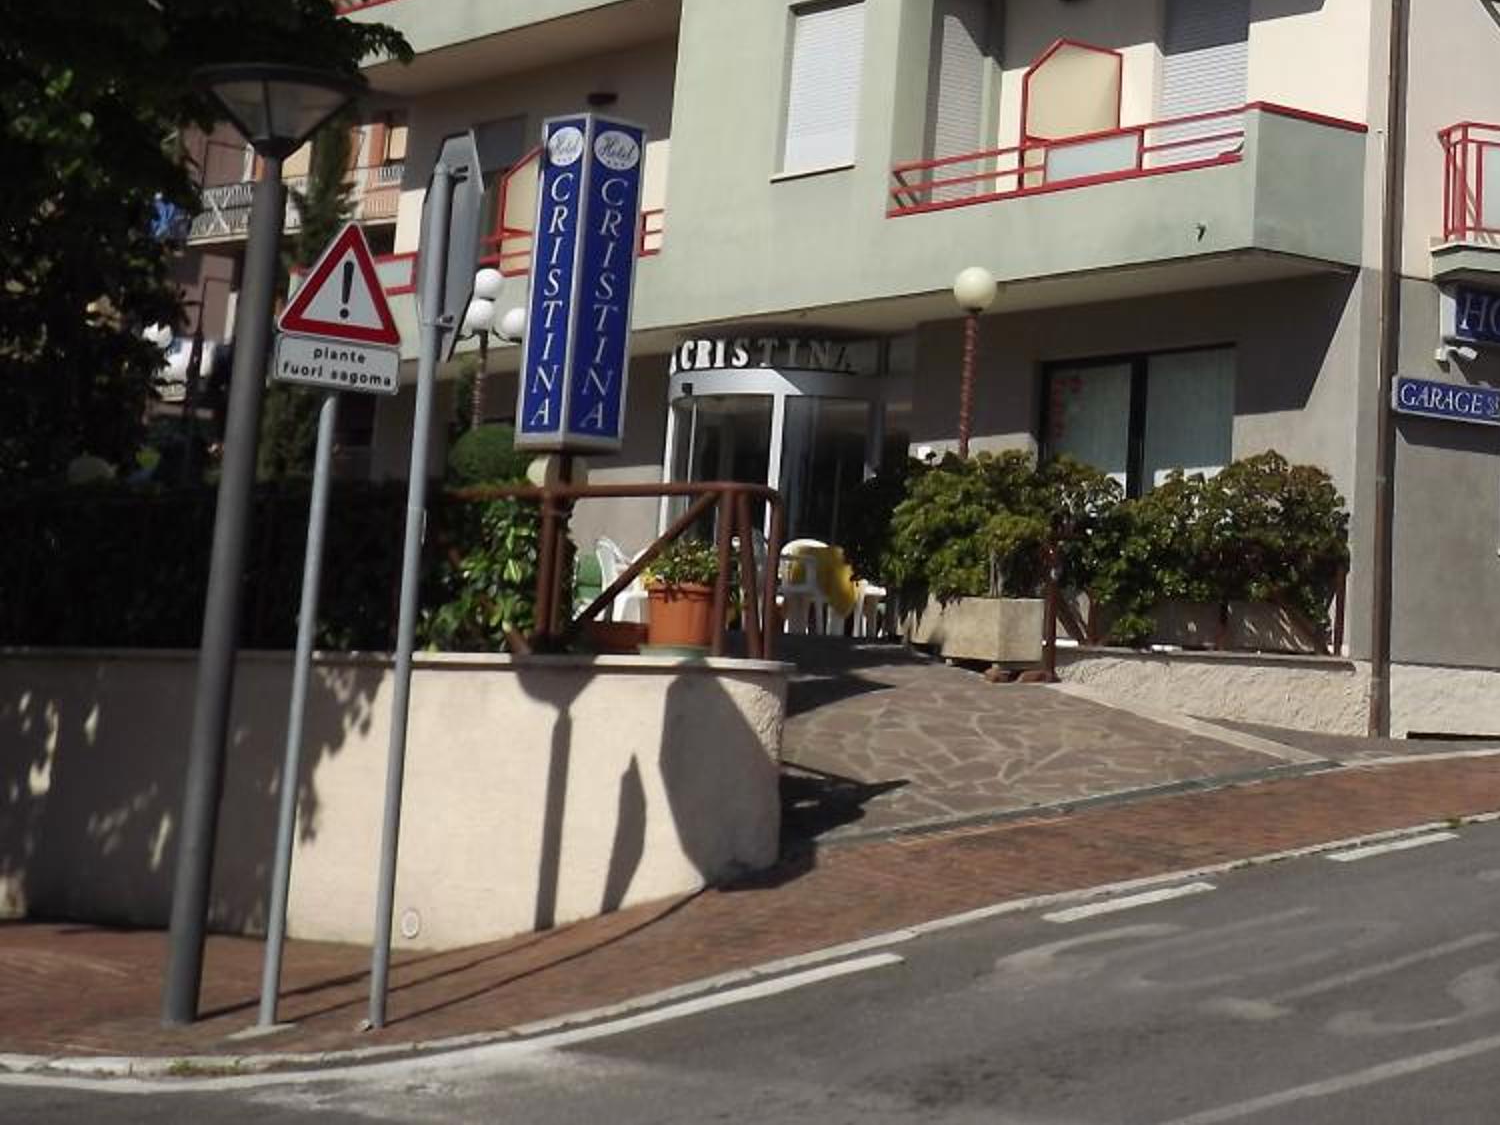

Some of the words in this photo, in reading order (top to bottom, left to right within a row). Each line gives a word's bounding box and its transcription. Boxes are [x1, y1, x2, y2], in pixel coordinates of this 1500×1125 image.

[530, 172, 574, 426] CRISTINA
[579, 178, 629, 430] CRISTINA
[313, 347, 366, 364] piante
[283, 361, 323, 377] fuori
[331, 371, 391, 387] sagoma
[1400, 383, 1483, 414] GARAGE
